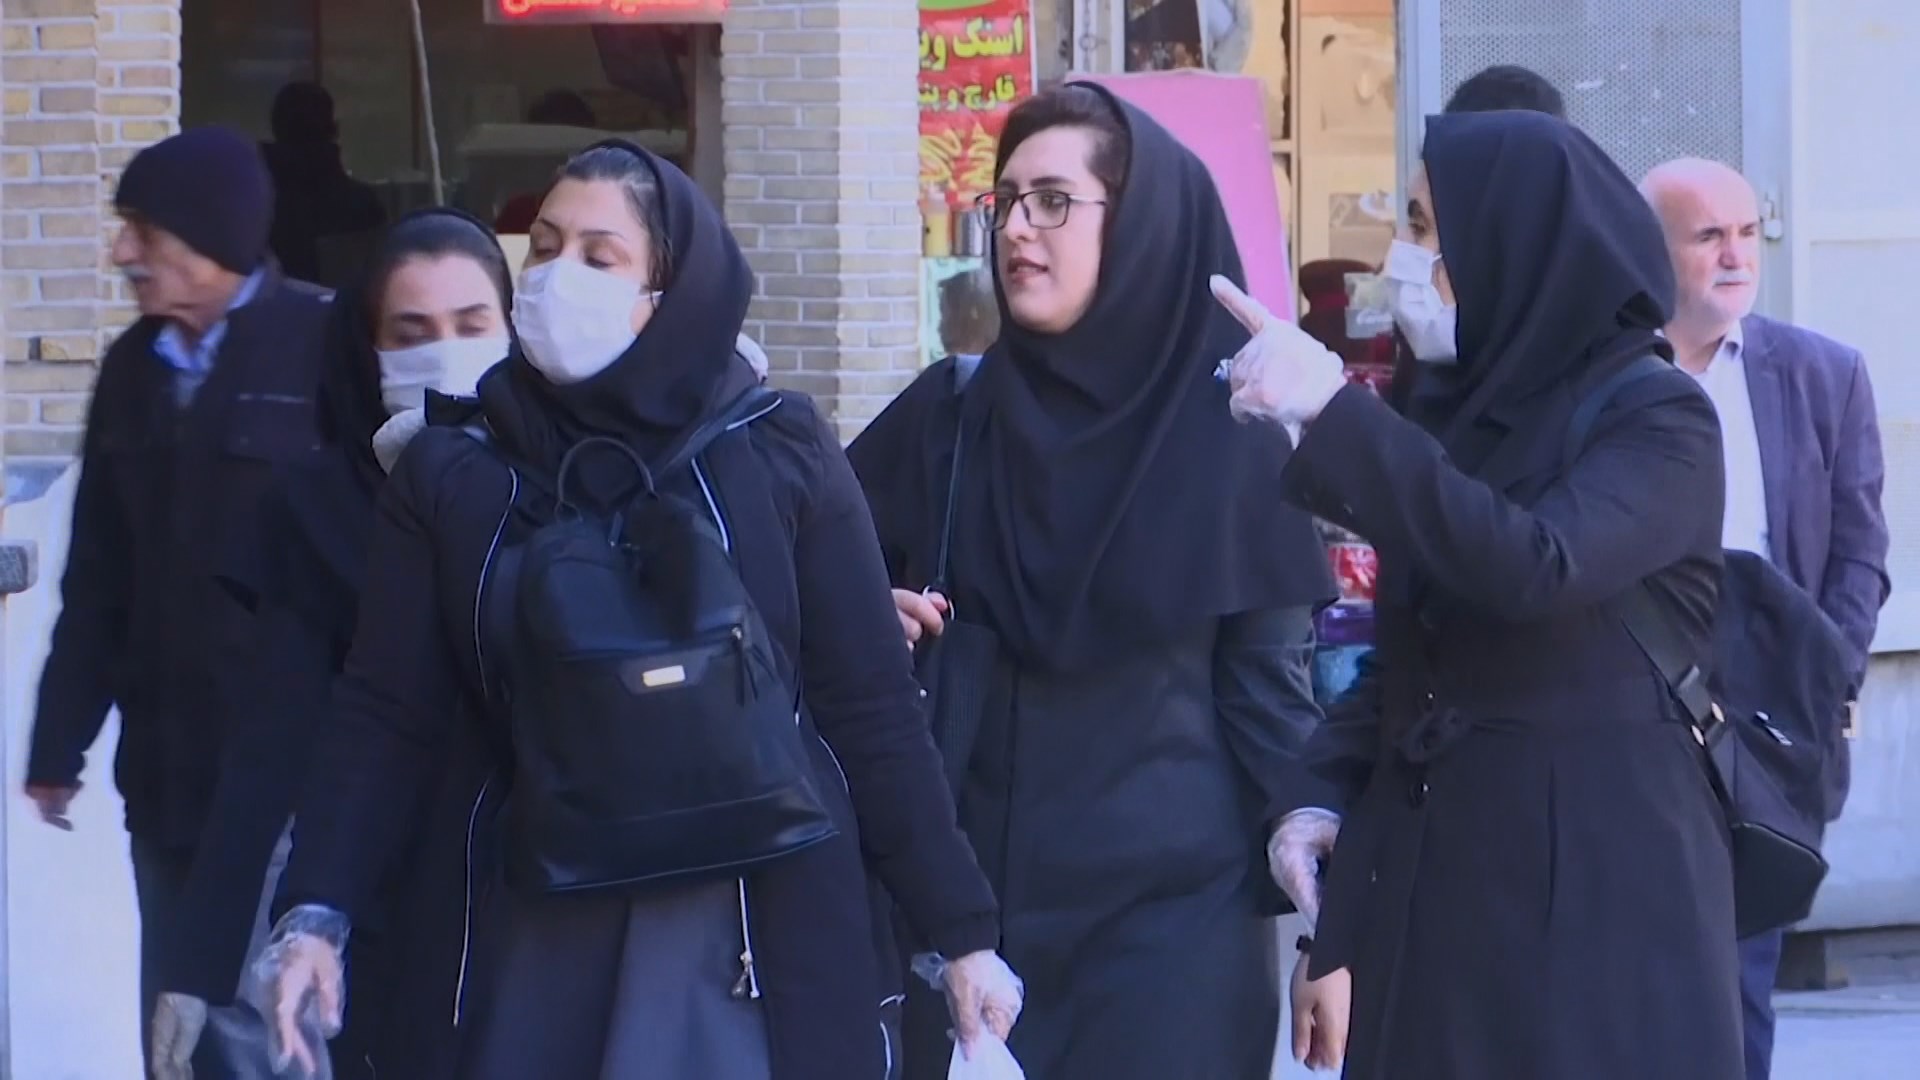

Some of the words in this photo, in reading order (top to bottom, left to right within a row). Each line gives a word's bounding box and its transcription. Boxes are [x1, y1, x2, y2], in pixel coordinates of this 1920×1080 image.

[919, 30, 947, 71] وی
[953, 14, 1024, 58] اسنک
[919, 82, 940, 112] پن
[946, 87, 959, 111] و
[964, 73, 1016, 110] قارچ
